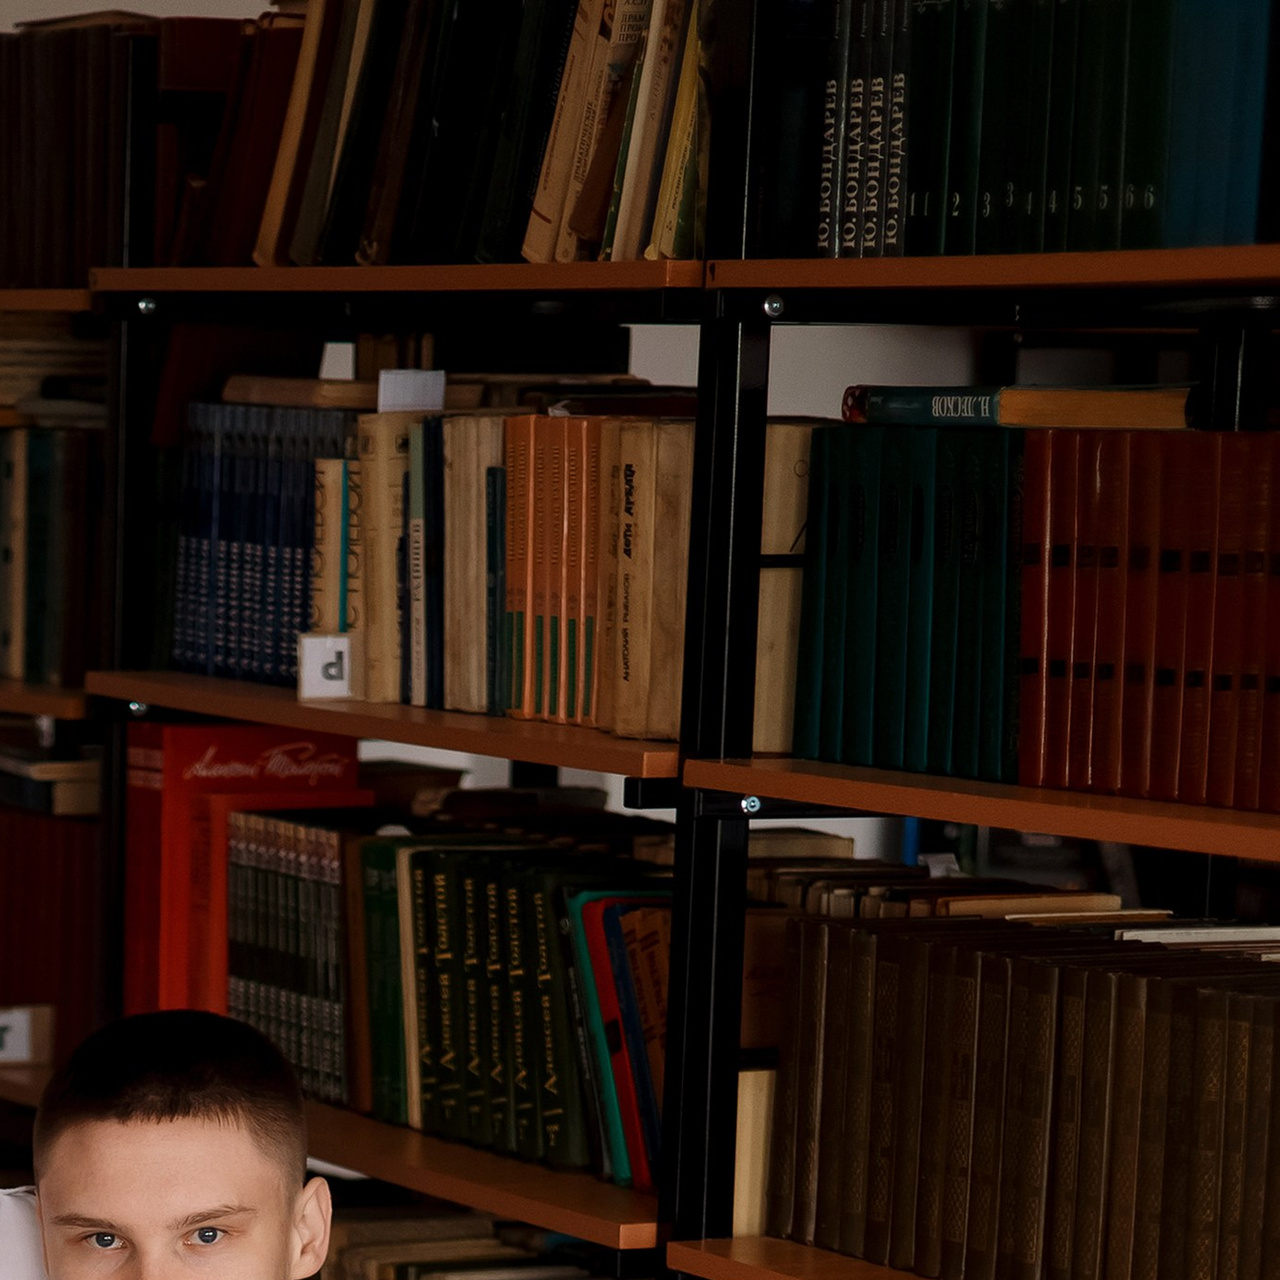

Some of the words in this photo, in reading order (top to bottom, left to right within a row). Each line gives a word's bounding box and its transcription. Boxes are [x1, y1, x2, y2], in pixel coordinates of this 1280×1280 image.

[819, 79, 837, 214] БОНДАРЕВ
[844, 78, 864, 212] БОНДАРЕВ
[865, 76, 886, 212] БОНДАРЕВ
[887, 72, 906, 210] БОНДАРЕВ
[951, 192, 960, 217] 2
[982, 191, 991, 218] 3
[1005, 182, 1014, 207] 3
[1073, 186, 1083, 212] 5
[1143, 185, 1154, 210] 6
[817, 218, 830, 249] Ю.
[842, 215, 856, 249] Ю.
[863, 215, 877, 249] Ю.
[885, 213, 898, 245] Ю.
[932, 396, 976, 417] ЛЕСКОВ
[624, 464, 635, 517] АРБАТА
[622, 573, 630, 623] РЫБАКОВ
[322, 651, 344, 681] Р
[622, 628, 630, 682] АНАТОЛИЙ
[434, 872, 453, 967] Толстой
[463, 877, 479, 972] Толстой
[486, 882, 501, 978] Толстой
[507, 886, 525, 983] Толстой
[534, 891, 553, 989] Толстой
